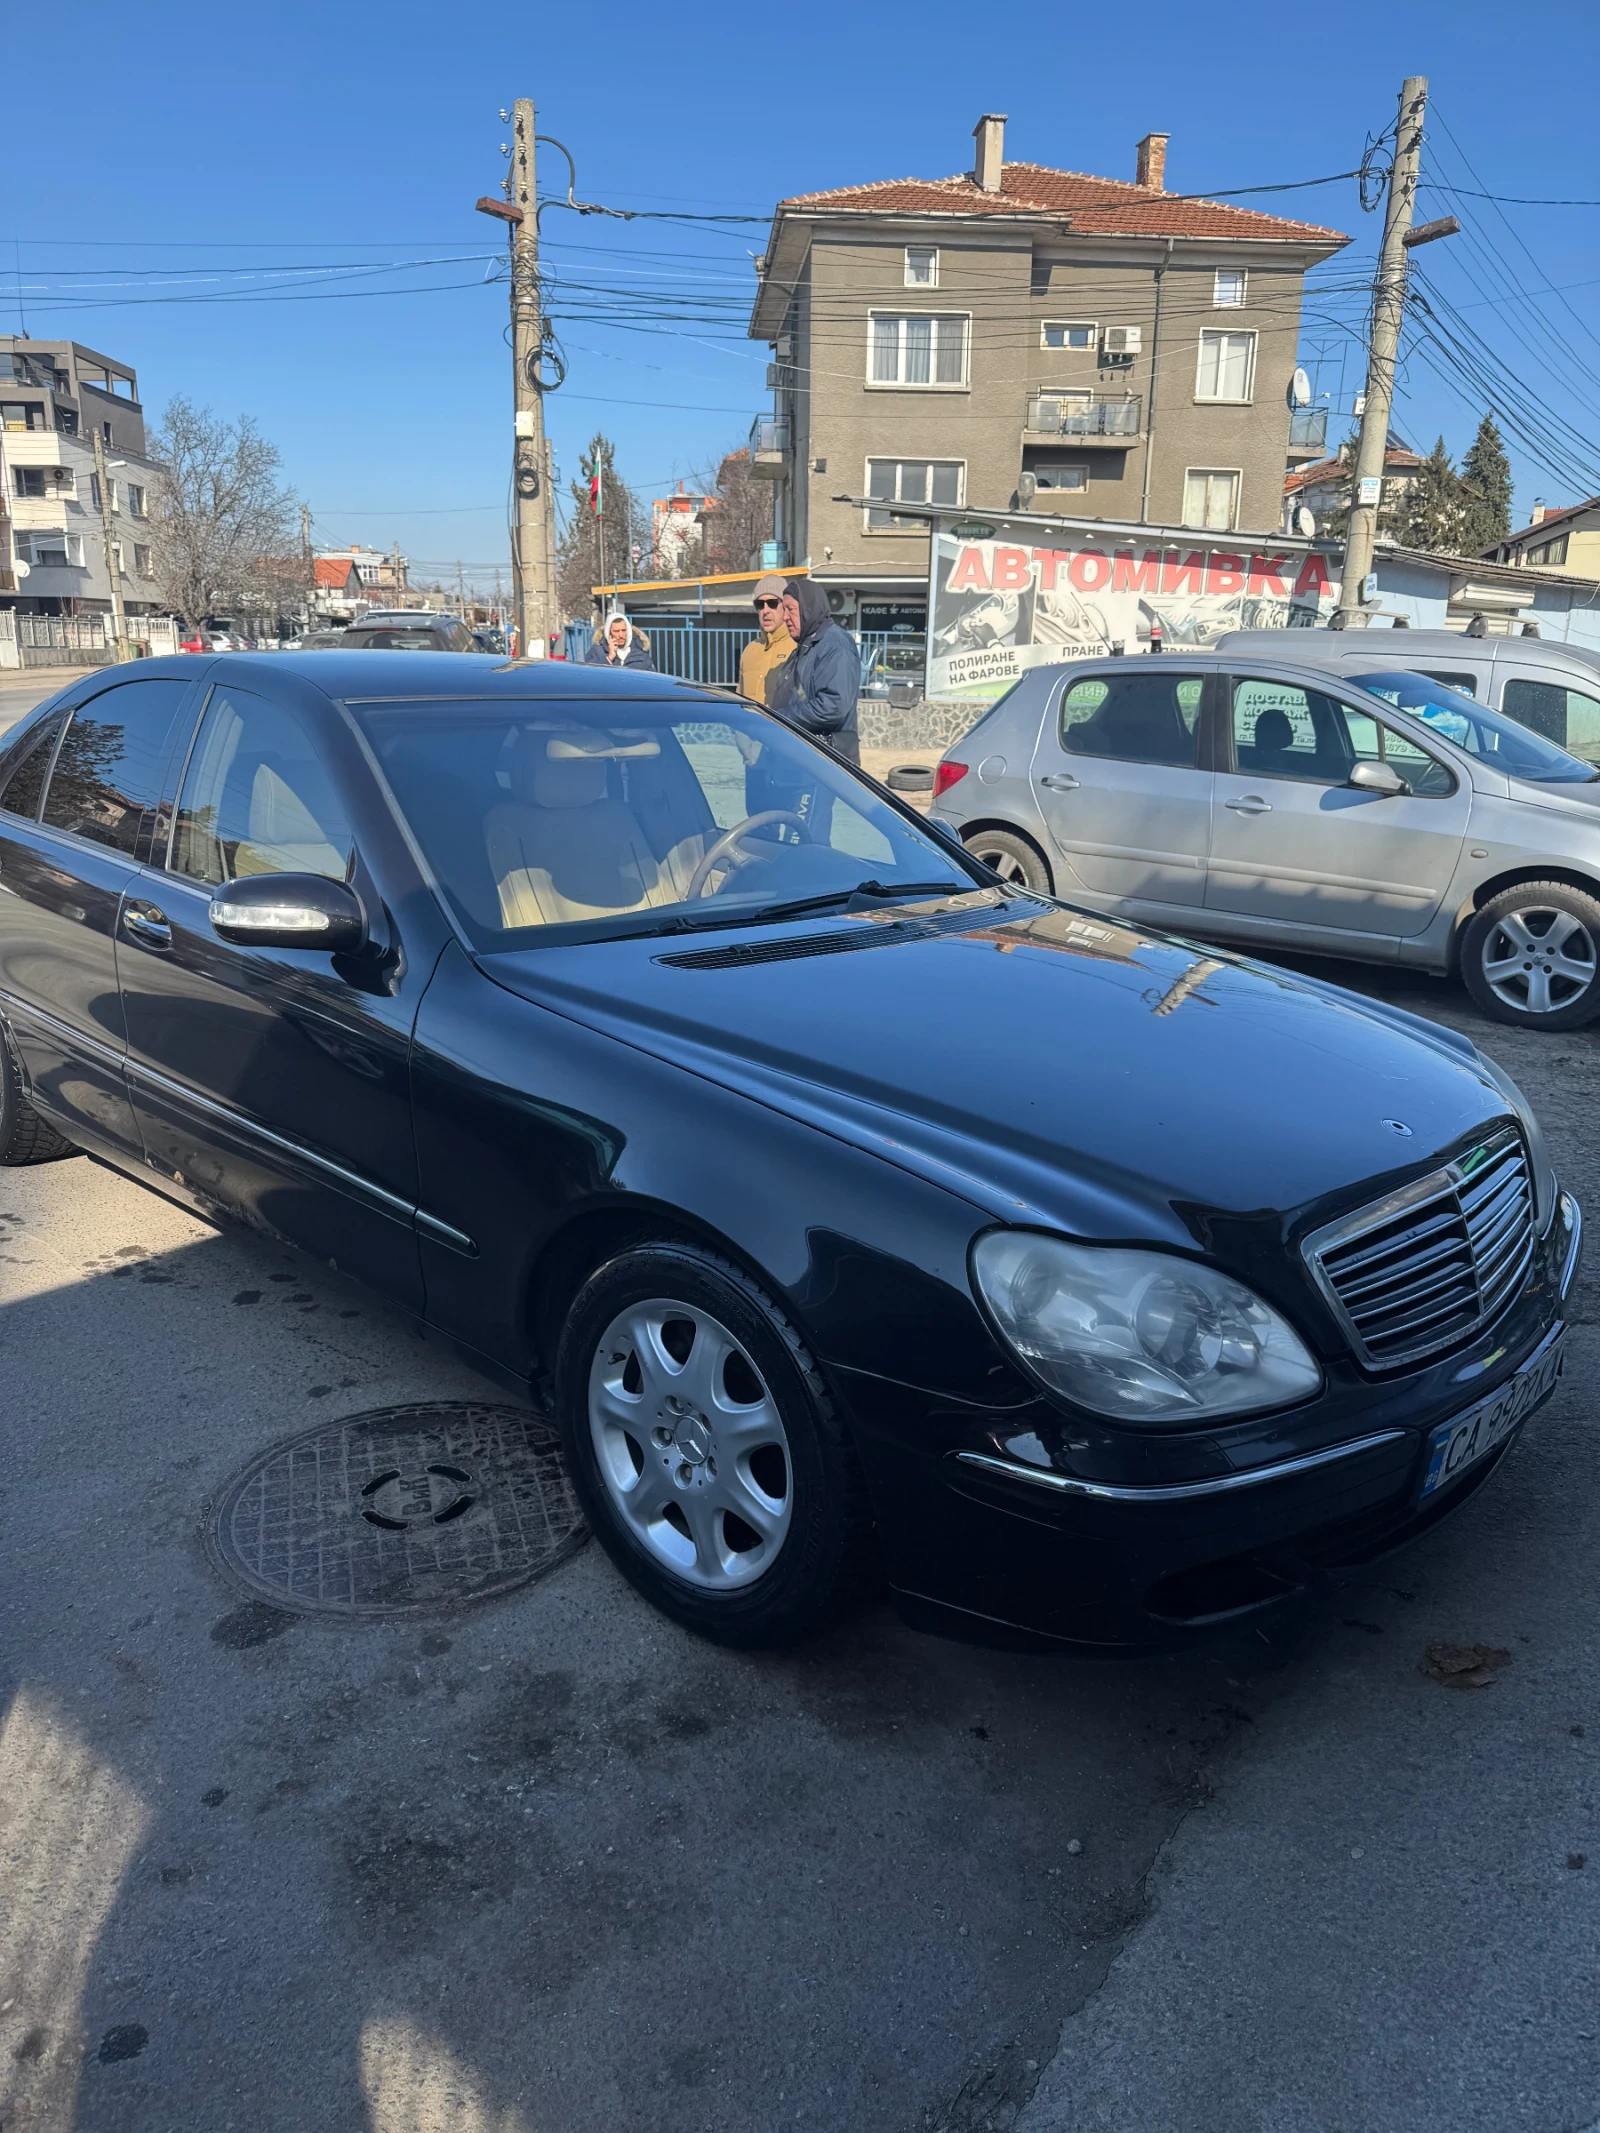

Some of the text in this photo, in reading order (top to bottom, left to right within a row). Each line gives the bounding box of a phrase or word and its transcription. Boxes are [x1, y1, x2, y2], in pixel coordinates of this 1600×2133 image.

[948, 546, 1335, 597] АВТОМИВКА
[949, 651, 1016, 672] ПОЛИРАНЕ
[1062, 645, 1104, 657] ПРАНЕ
[949, 664, 1021, 685] НА ФАРОВЕ
[1444, 1417, 1482, 1475] CA
